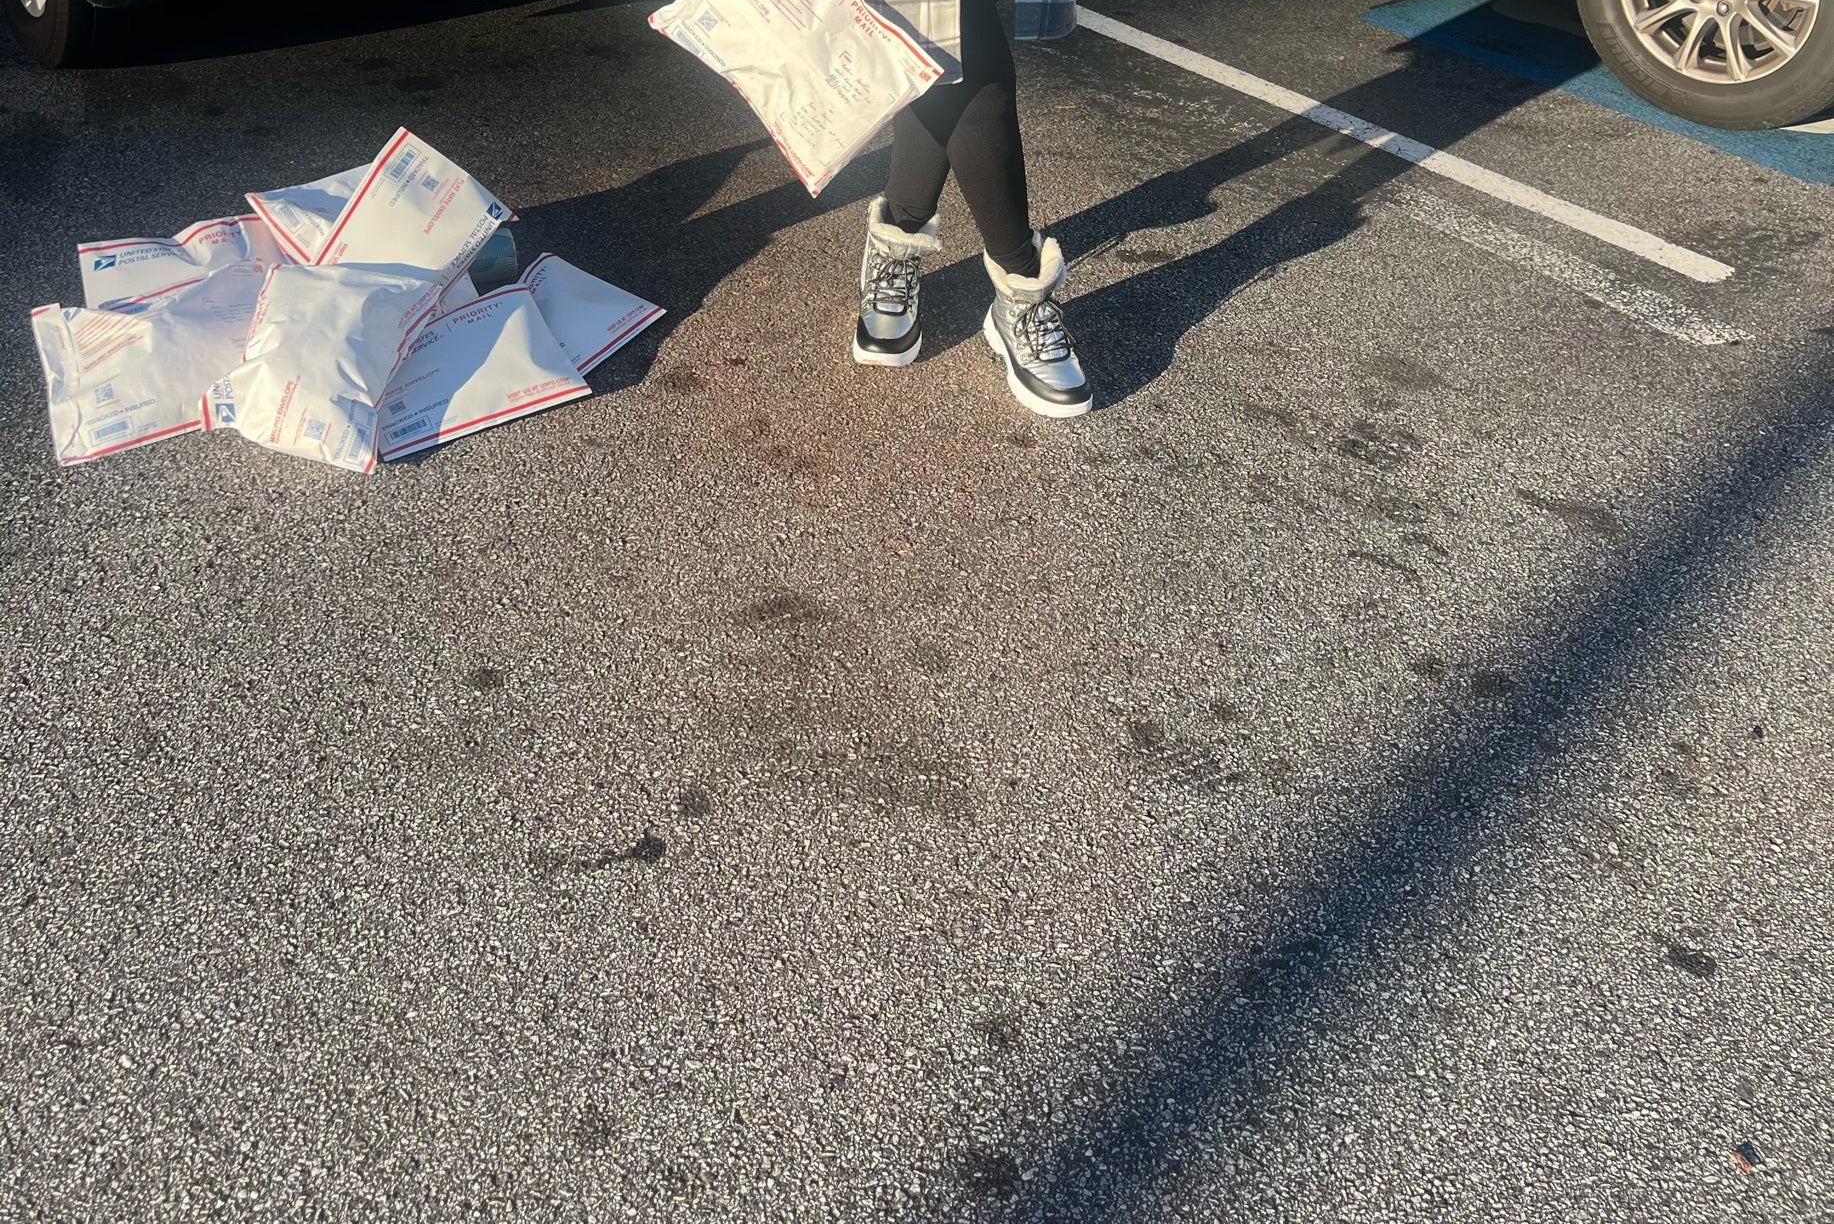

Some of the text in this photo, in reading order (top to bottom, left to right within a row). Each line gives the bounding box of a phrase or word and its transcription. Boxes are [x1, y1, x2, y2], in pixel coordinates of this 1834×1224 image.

[854, 16, 874, 38] MAIL
[423, 203, 447, 235] ENVELOPE
[469, 214, 488, 242] POSTAL
[118, 254, 151, 266] POSTAL
[119, 247, 151, 259] UNITED
[453, 303, 499, 324] PRIORITY
[467, 313, 492, 324] MAIL
[418, 398, 449, 414] INSURED
